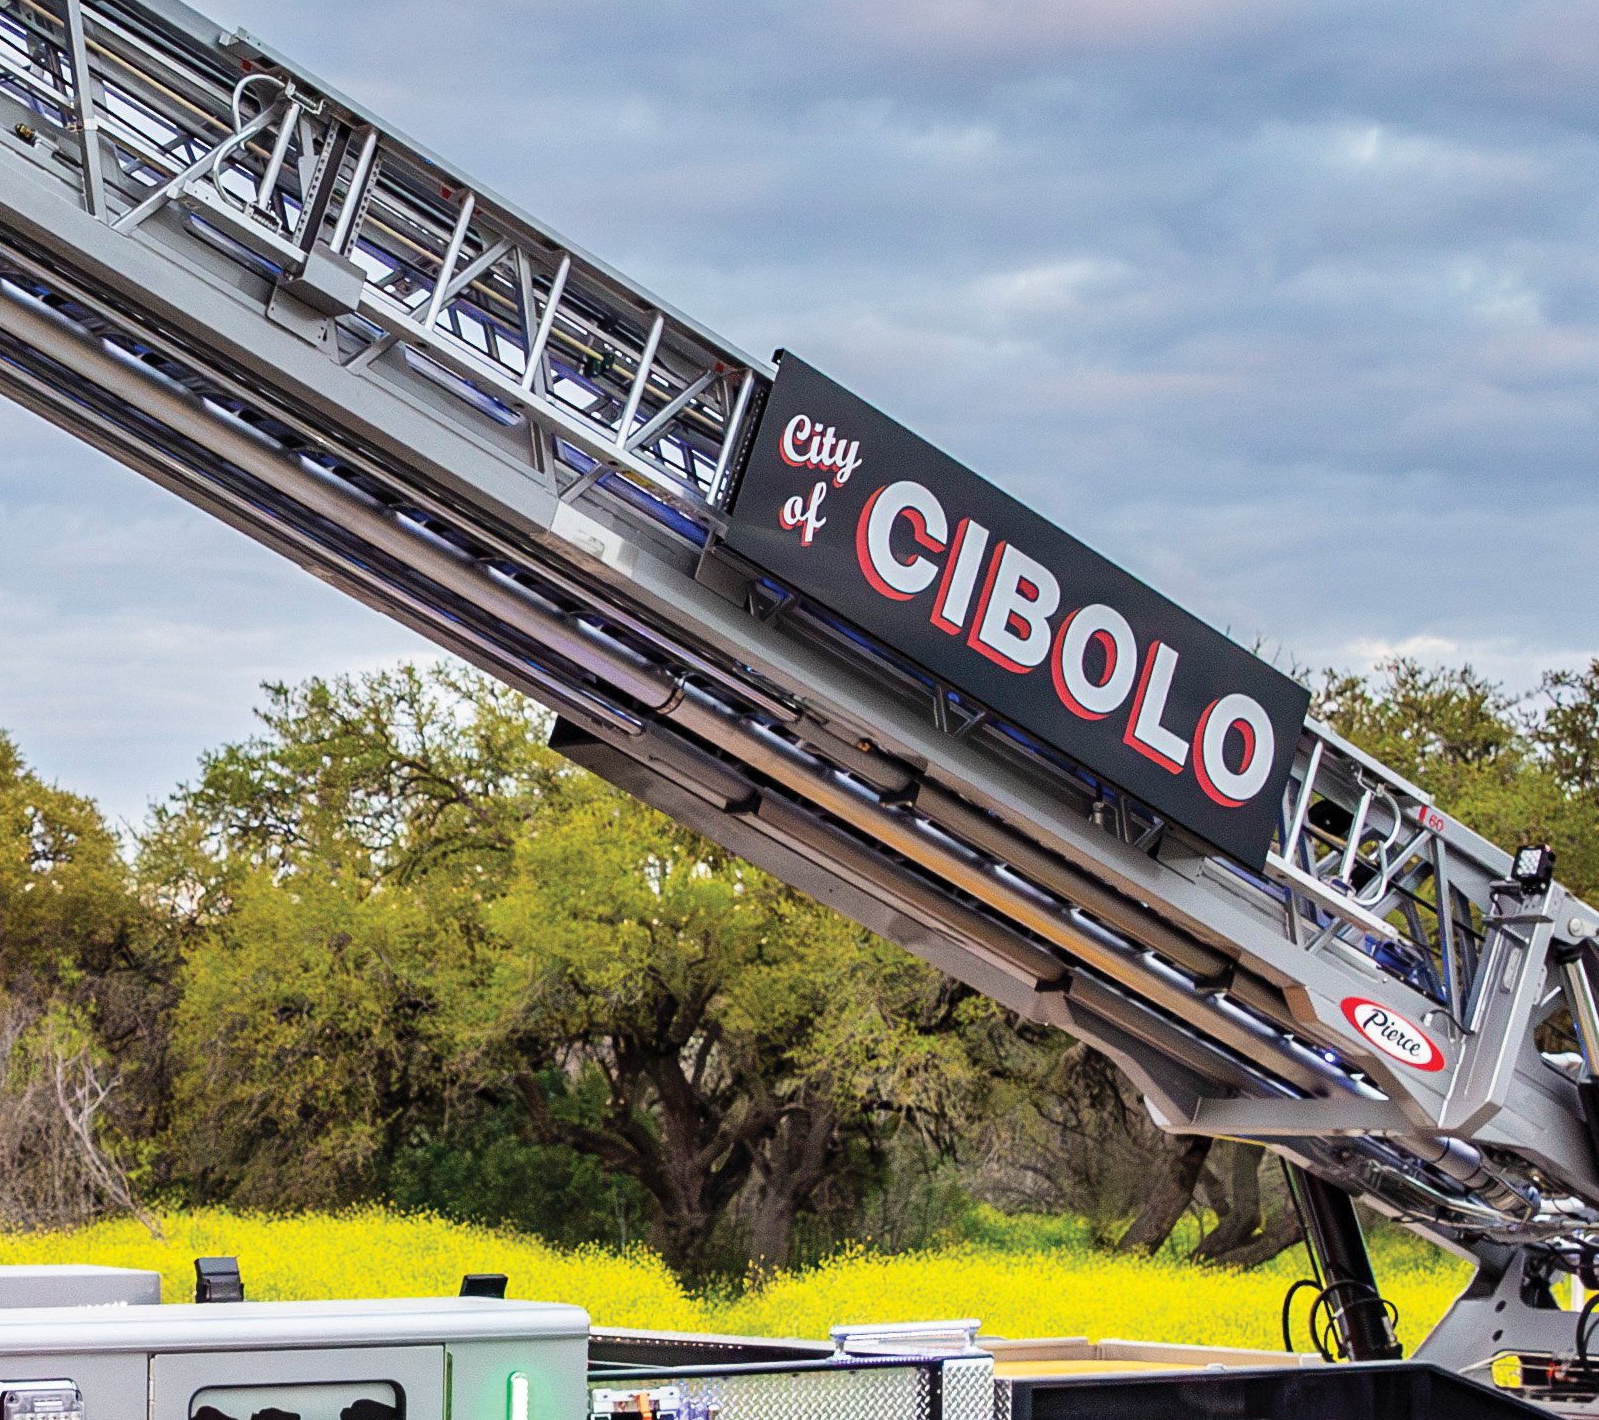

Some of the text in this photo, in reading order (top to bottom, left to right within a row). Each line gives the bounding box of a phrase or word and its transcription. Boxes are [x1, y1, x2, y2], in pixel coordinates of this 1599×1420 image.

[780, 413, 862, 486] City
[780, 480, 827, 546] of
[856, 480, 1275, 808] CIBOLO
[1429, 814, 1444, 832] 60
[1363, 1008, 1421, 1056] Pierce
